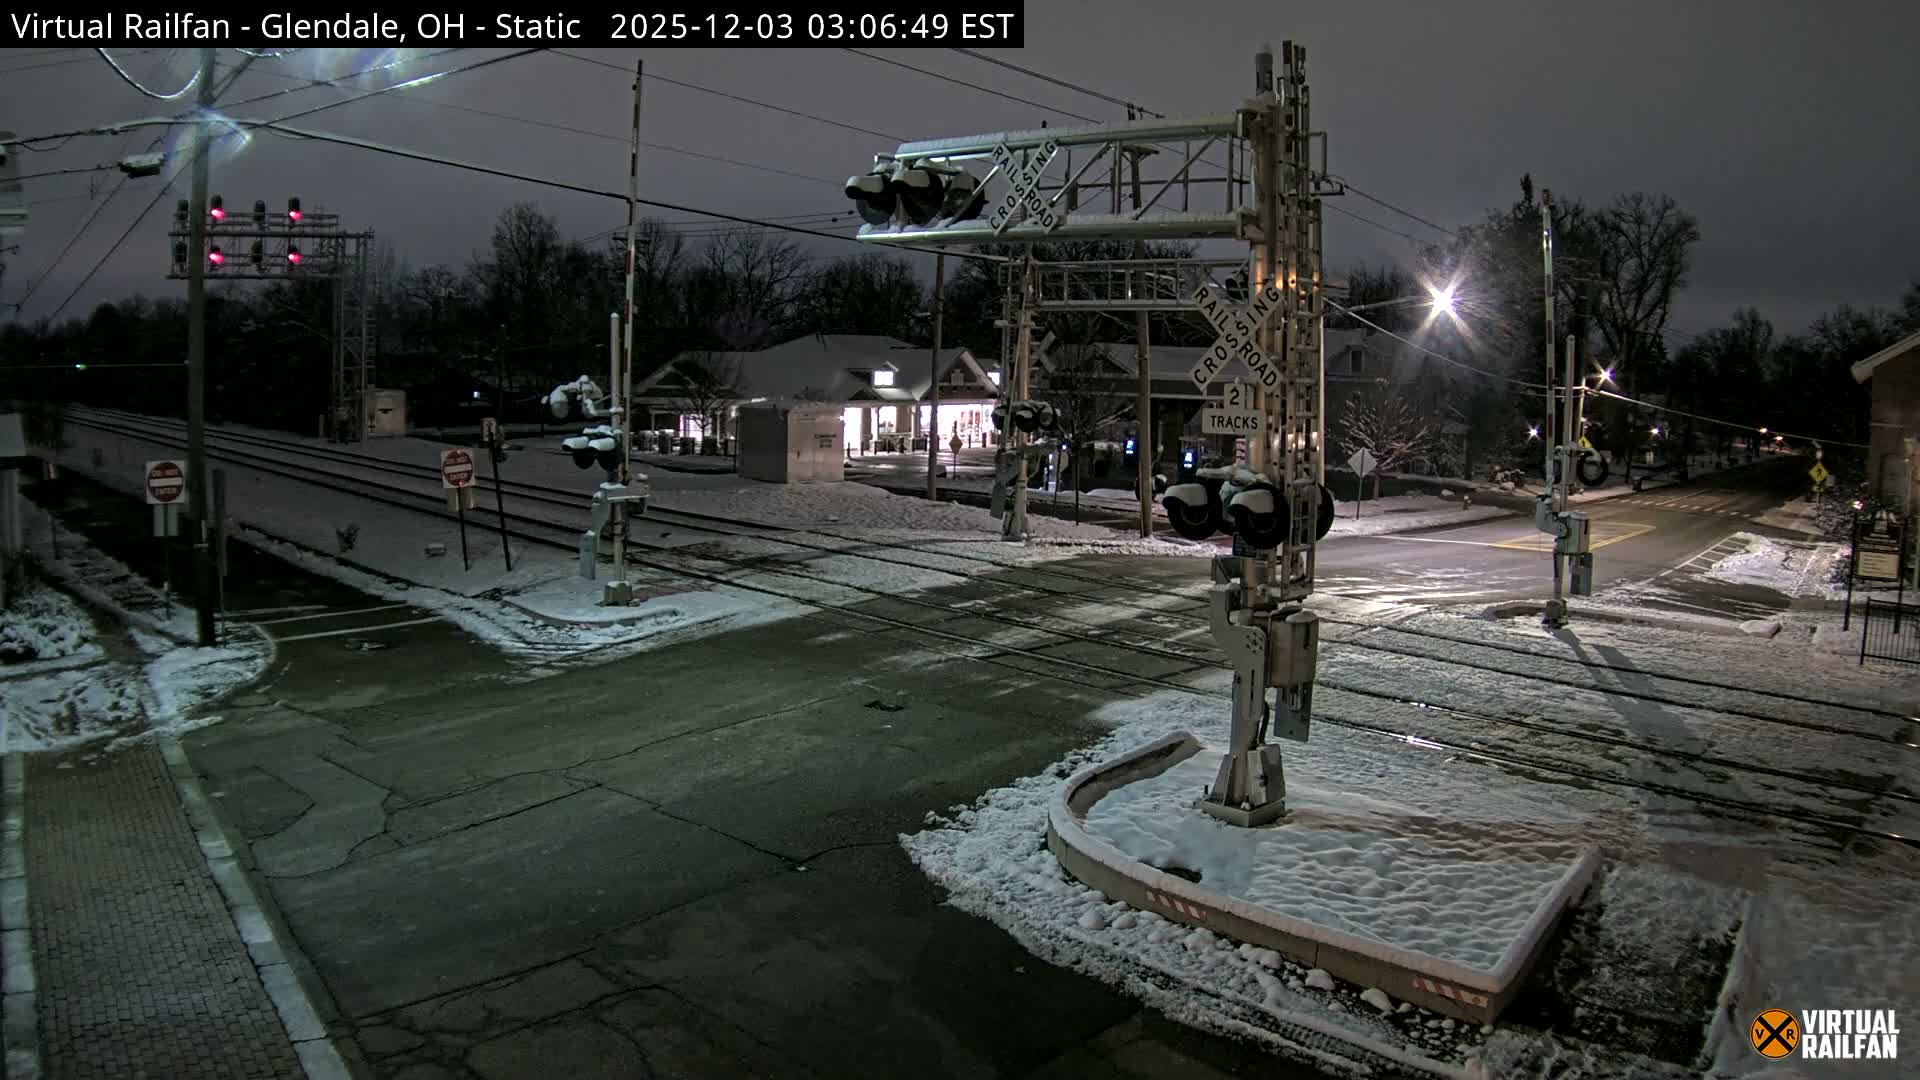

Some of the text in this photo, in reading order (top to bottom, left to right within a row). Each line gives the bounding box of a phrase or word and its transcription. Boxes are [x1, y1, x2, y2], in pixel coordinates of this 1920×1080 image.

[990, 141, 1055, 230] CROSSING
[993, 146, 1054, 228] RAILROAD
[1194, 287, 1279, 384] CROSSING
[1195, 287, 1277, 387] RAILROAD
[1210, 415, 1258, 430] TRACKS
[1229, 387, 1240, 406] 2
